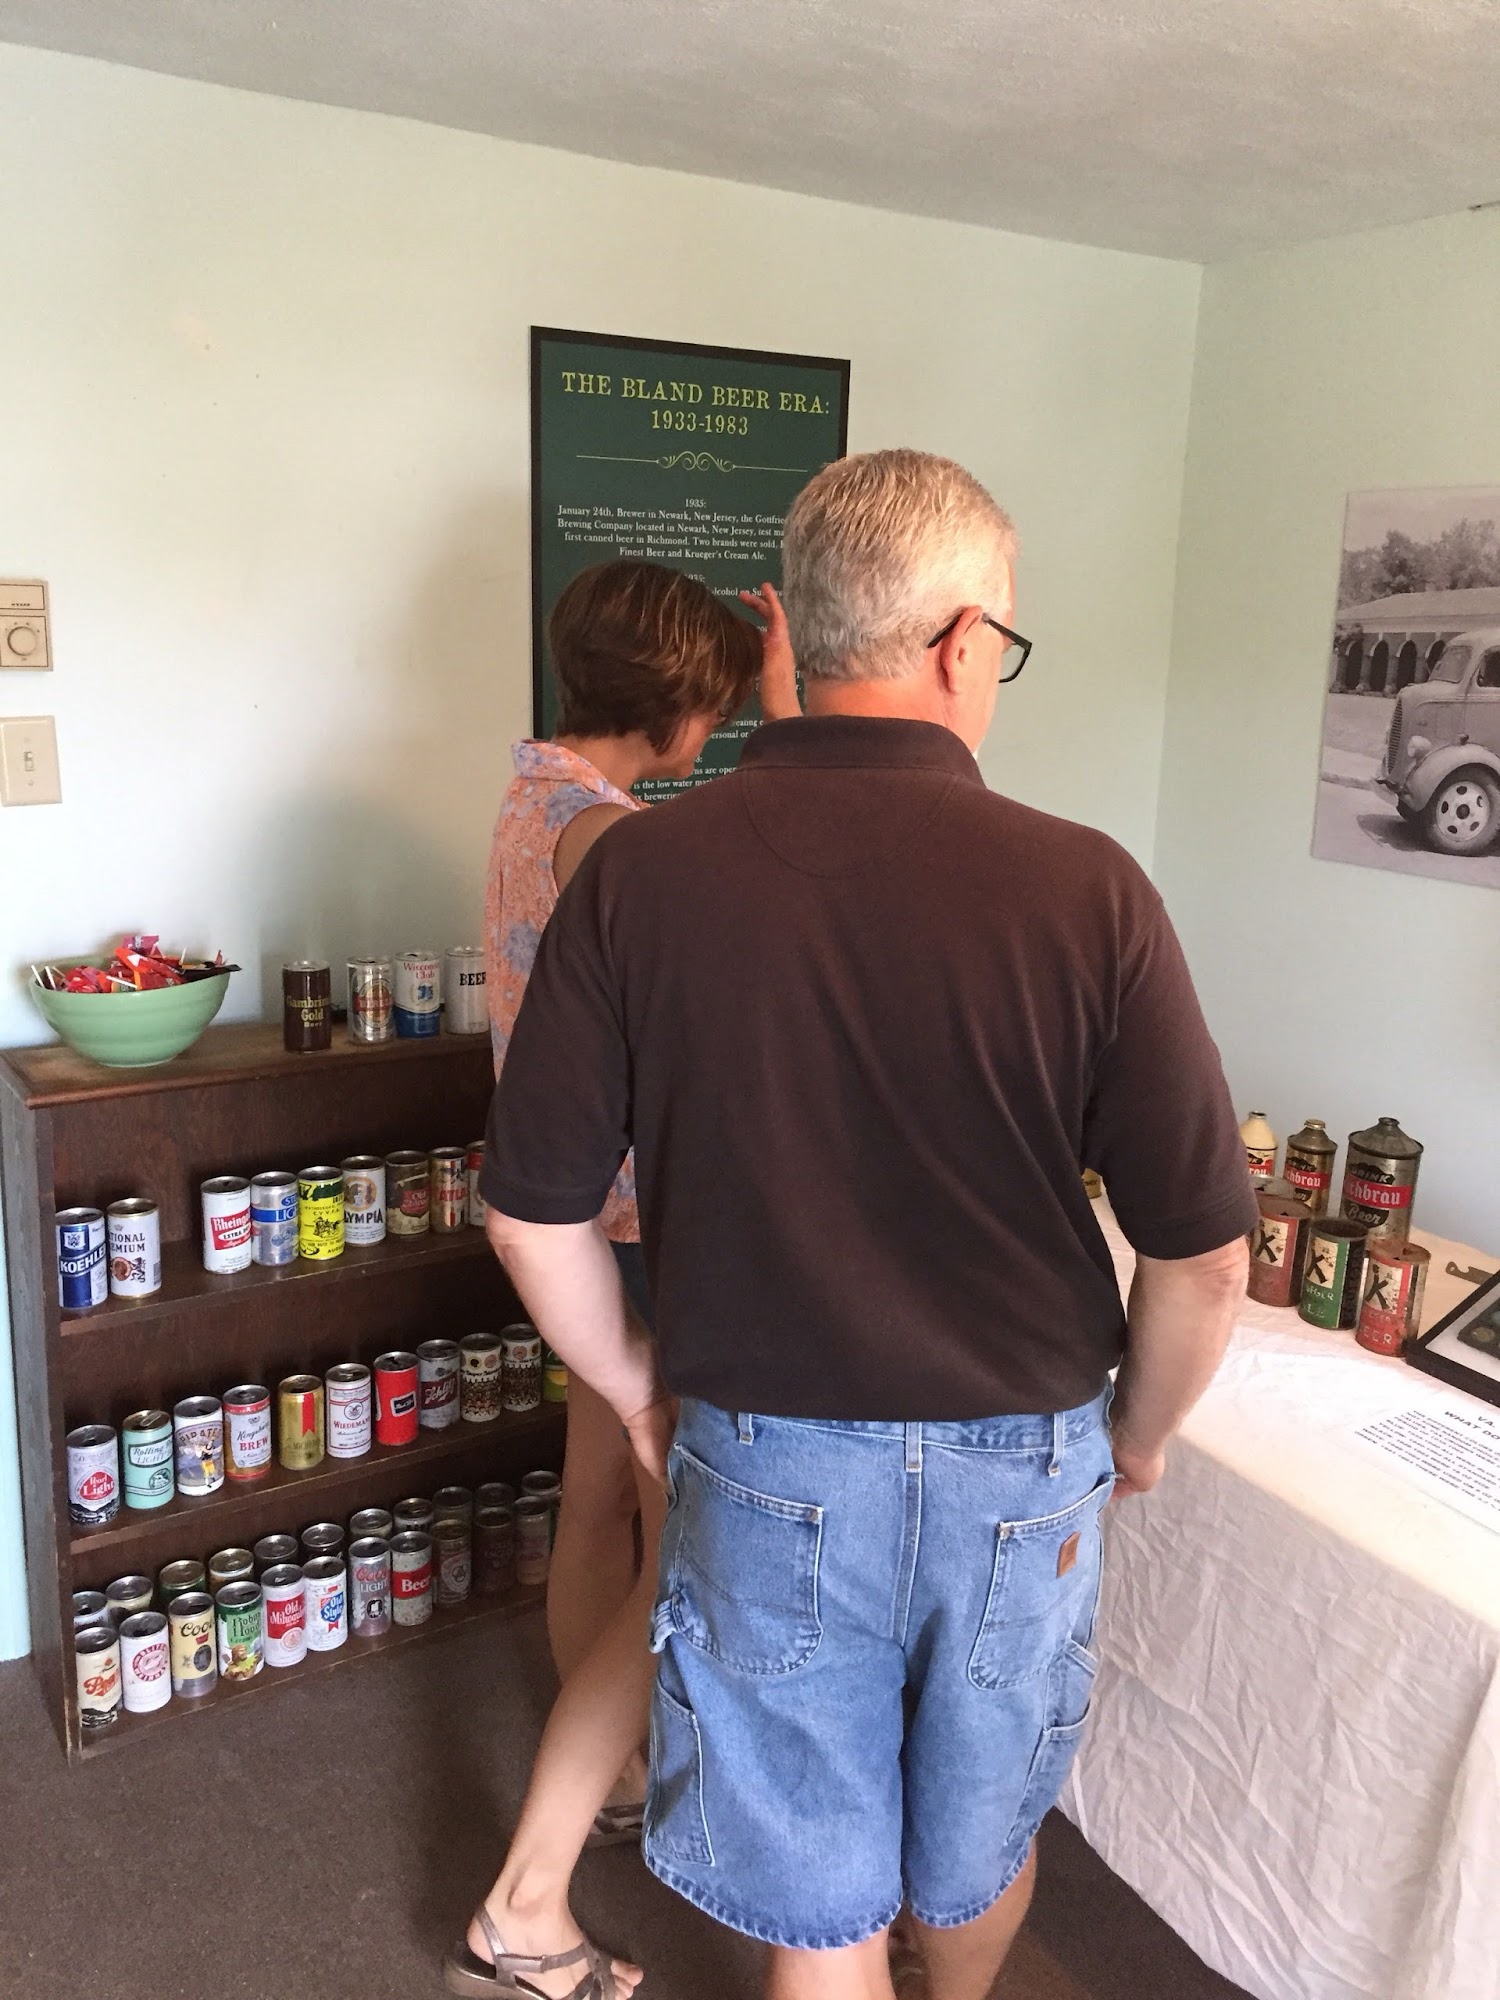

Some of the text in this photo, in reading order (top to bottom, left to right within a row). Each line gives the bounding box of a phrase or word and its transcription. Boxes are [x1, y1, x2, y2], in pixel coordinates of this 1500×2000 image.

[562, 372, 830, 415] THE BLAND BEER ERA:
[651, 409, 748, 435] 1933-1983
[685, 498, 706, 508] 1935:
[557, 505, 591, 517] January
[593, 506, 614, 517] 24th,
[617, 508, 646, 519] Brewer
[648, 510, 656, 519] in
[658, 510, 691, 521] Newark,
[694, 511, 711, 521] New
[712, 512, 739, 523] Jersey,
[740, 514, 753, 523] the
[557, 518, 592, 530] Brewing
[594, 520, 633, 532] Company
[635, 522, 665, 532] located
[667, 523, 675, 532] in
[677, 523, 709, 534] Newark,
[712, 525, 729, 534] New
[730, 526, 756, 536] Jersey,
[758, 528, 771, 536] test
[565, 532, 778, 549] first canned beer in Richmond. Two brands were sold,
[619, 546, 767, 560] Finest Beer and Krueger's Cream Ale.
[712, 587, 738, 596] lcohol
[740, 731, 749, 739] or
[705, 767, 716, 775] are
[642, 780, 655, 789] the
[657, 780, 670, 789] low
[672, 780, 693, 788] water
[301, 1008, 324, 1020] Gold
[223, 1229, 242, 1240] EXTRA
[1444, 1411, 1481, 1430] WHAT
[240, 1436, 268, 1451] BREW
[133, 1445, 164, 1457] Rolling
[83, 1481, 115, 1499] Light
[284, 1600, 299, 1615] Old
[329, 1594, 343, 1608] Old
